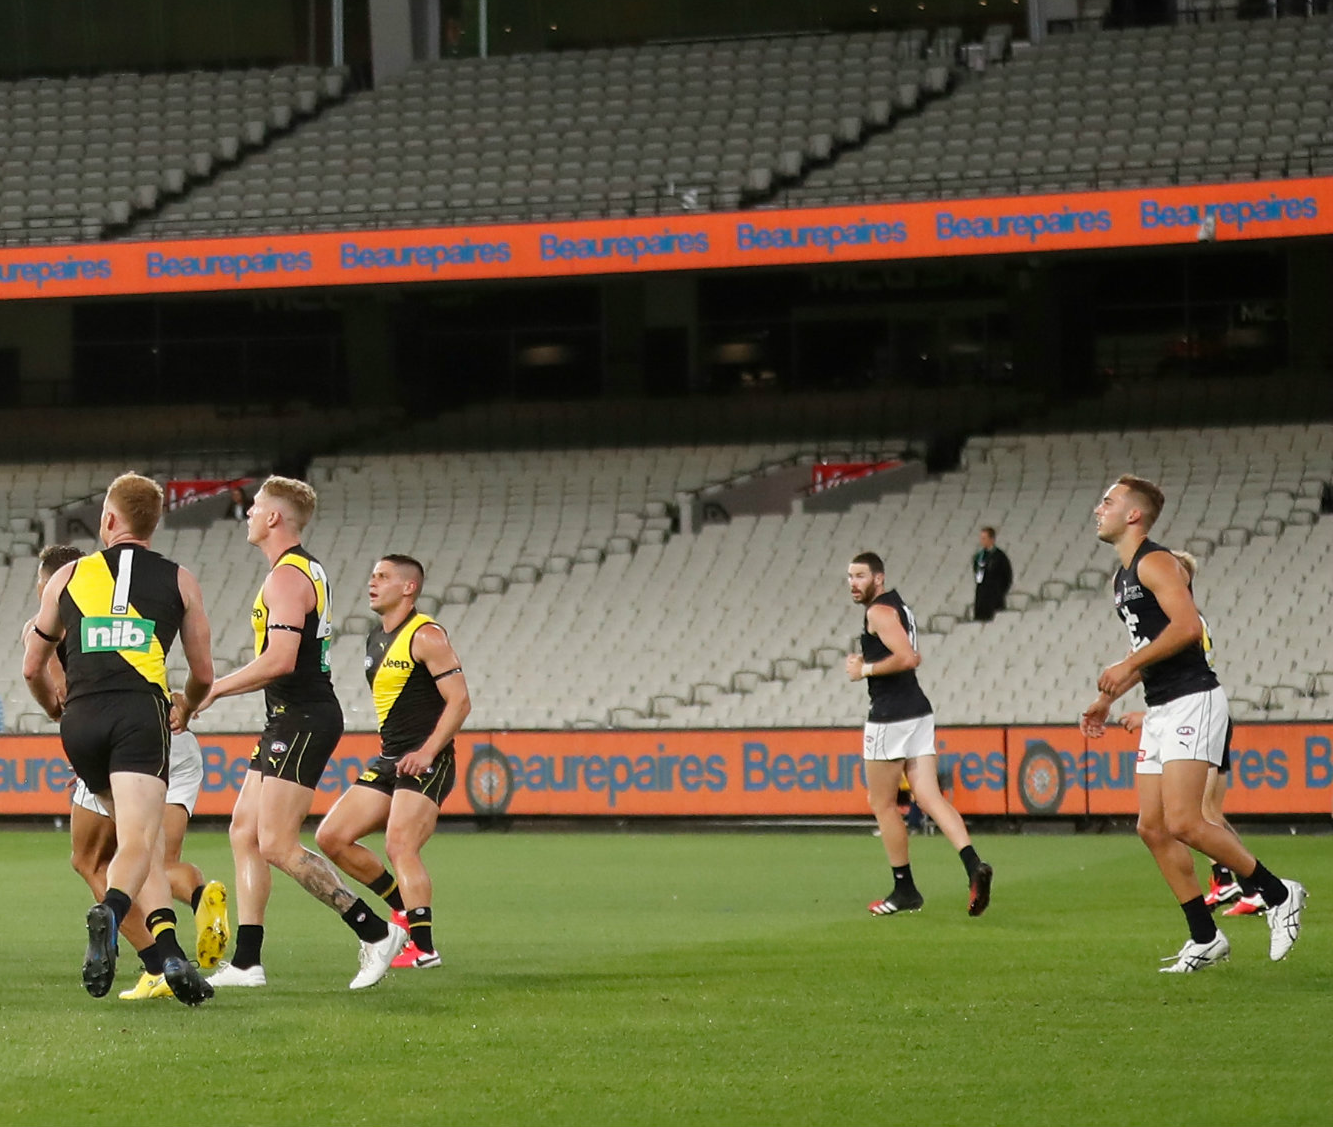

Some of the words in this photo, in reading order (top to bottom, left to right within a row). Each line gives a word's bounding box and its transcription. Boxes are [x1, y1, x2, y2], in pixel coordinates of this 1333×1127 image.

[146, 251, 312, 278] Beaurepaires
[340, 242, 511, 269] Beaurepaires
[539, 232, 708, 261] Beaurepaires
[736, 221, 907, 251] Beaurepaires
[935, 210, 1112, 241] Beaurepaires
[111, 549, 134, 615] 1
[88, 620, 145, 648] nib
[383, 657, 410, 670] Jeep
[1177, 727, 1194, 735] AFL
[471, 743, 729, 808] eaurepaires
